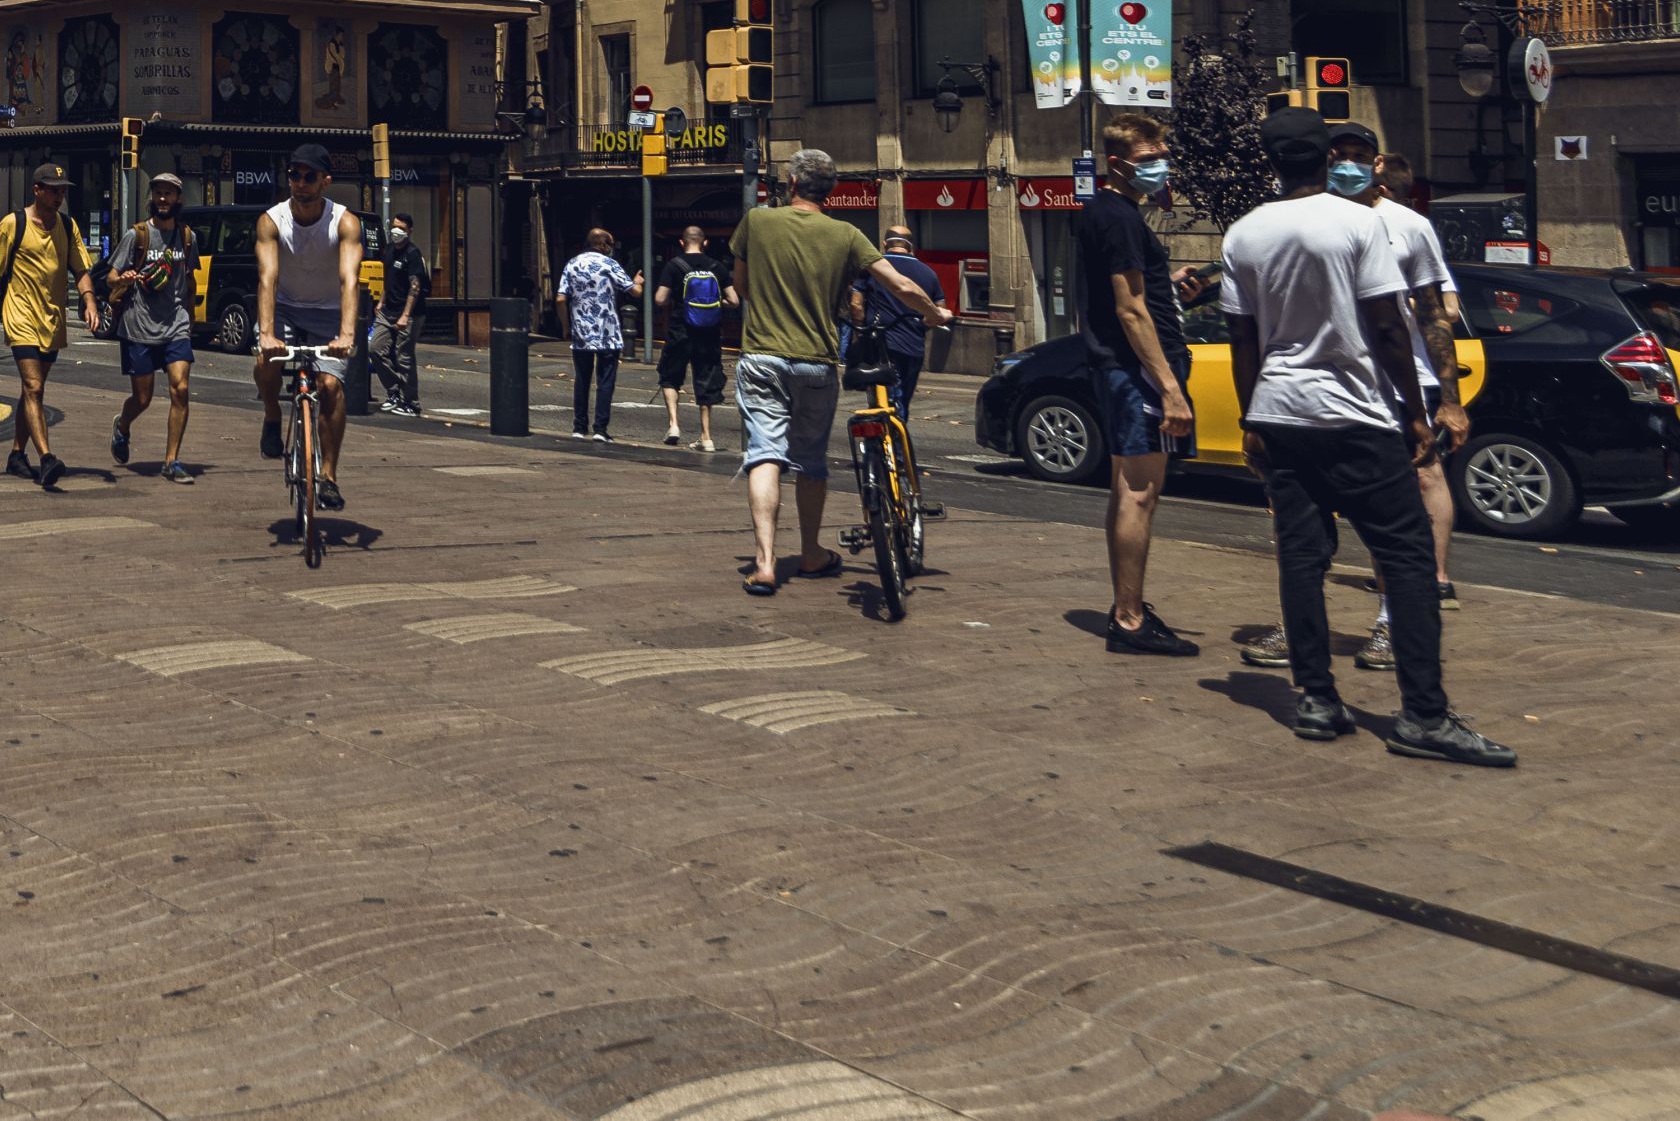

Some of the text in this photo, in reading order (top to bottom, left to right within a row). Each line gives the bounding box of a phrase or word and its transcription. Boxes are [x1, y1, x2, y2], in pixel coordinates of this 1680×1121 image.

[1039, 32, 1063, 40] ETS
[592, 130, 643, 152] HOSTA
[56, 167, 63, 176] P
[236, 171, 271, 184] BBVA
[1645, 195, 1680, 213] eu
